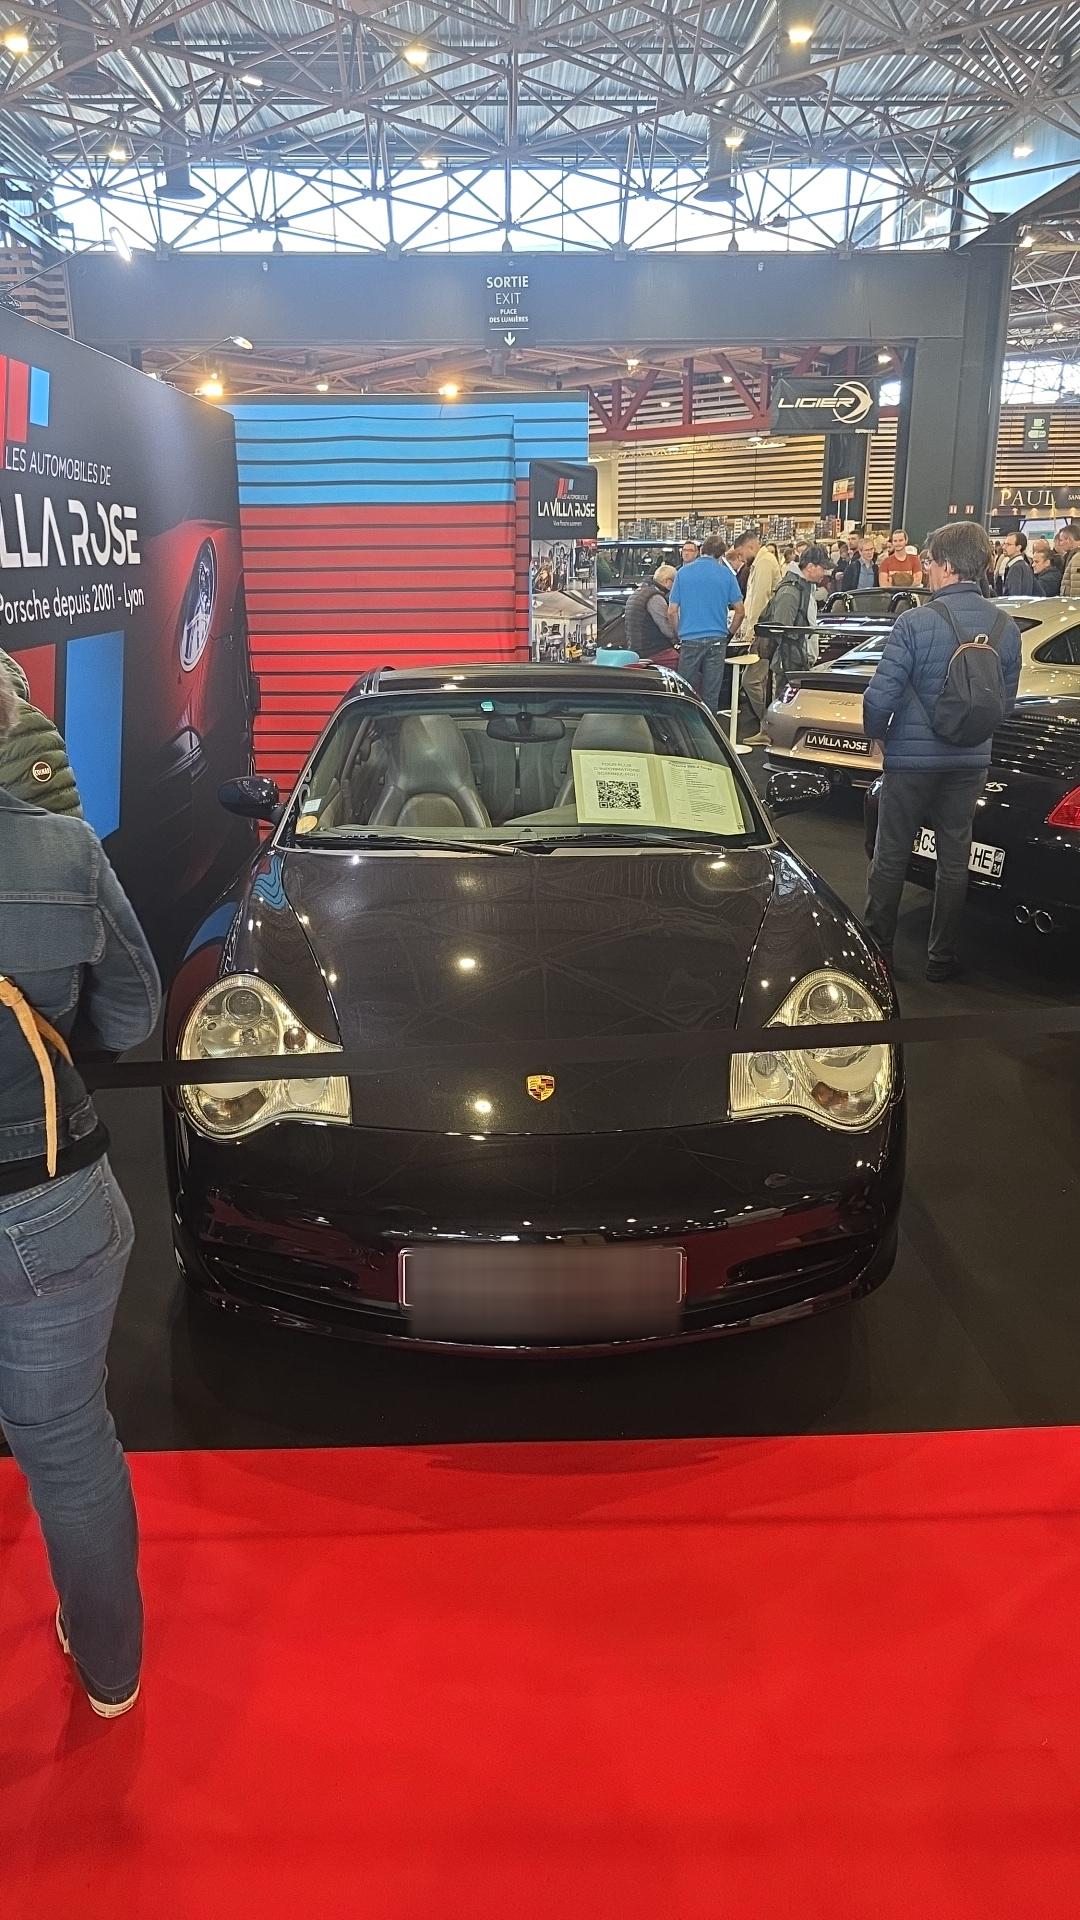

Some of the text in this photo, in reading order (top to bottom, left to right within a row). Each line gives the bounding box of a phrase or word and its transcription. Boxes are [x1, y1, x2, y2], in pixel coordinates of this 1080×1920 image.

[486, 276, 529, 289] SORTIE
[495, 292, 522, 305] EXIT
[501, 315, 529, 323] LUMIÈRES
[777, 397, 856, 409] LIGIER
[5, 445, 112, 486] LES AUTOMOBILES DE
[999, 489, 1056, 507] PAUL
[537, 500, 550, 517] LA
[550, 497, 574, 517] VILLA
[574, 502, 596, 518] ROSE
[68, 499, 141, 567] ROSE
[53, 585, 91, 625] depuis
[91, 583, 116, 612] 2001
[123, 581, 145, 615] Lyon
[806, 734, 869, 751] LA VILLA ROSE
[992, 863, 1001, 875] 34
